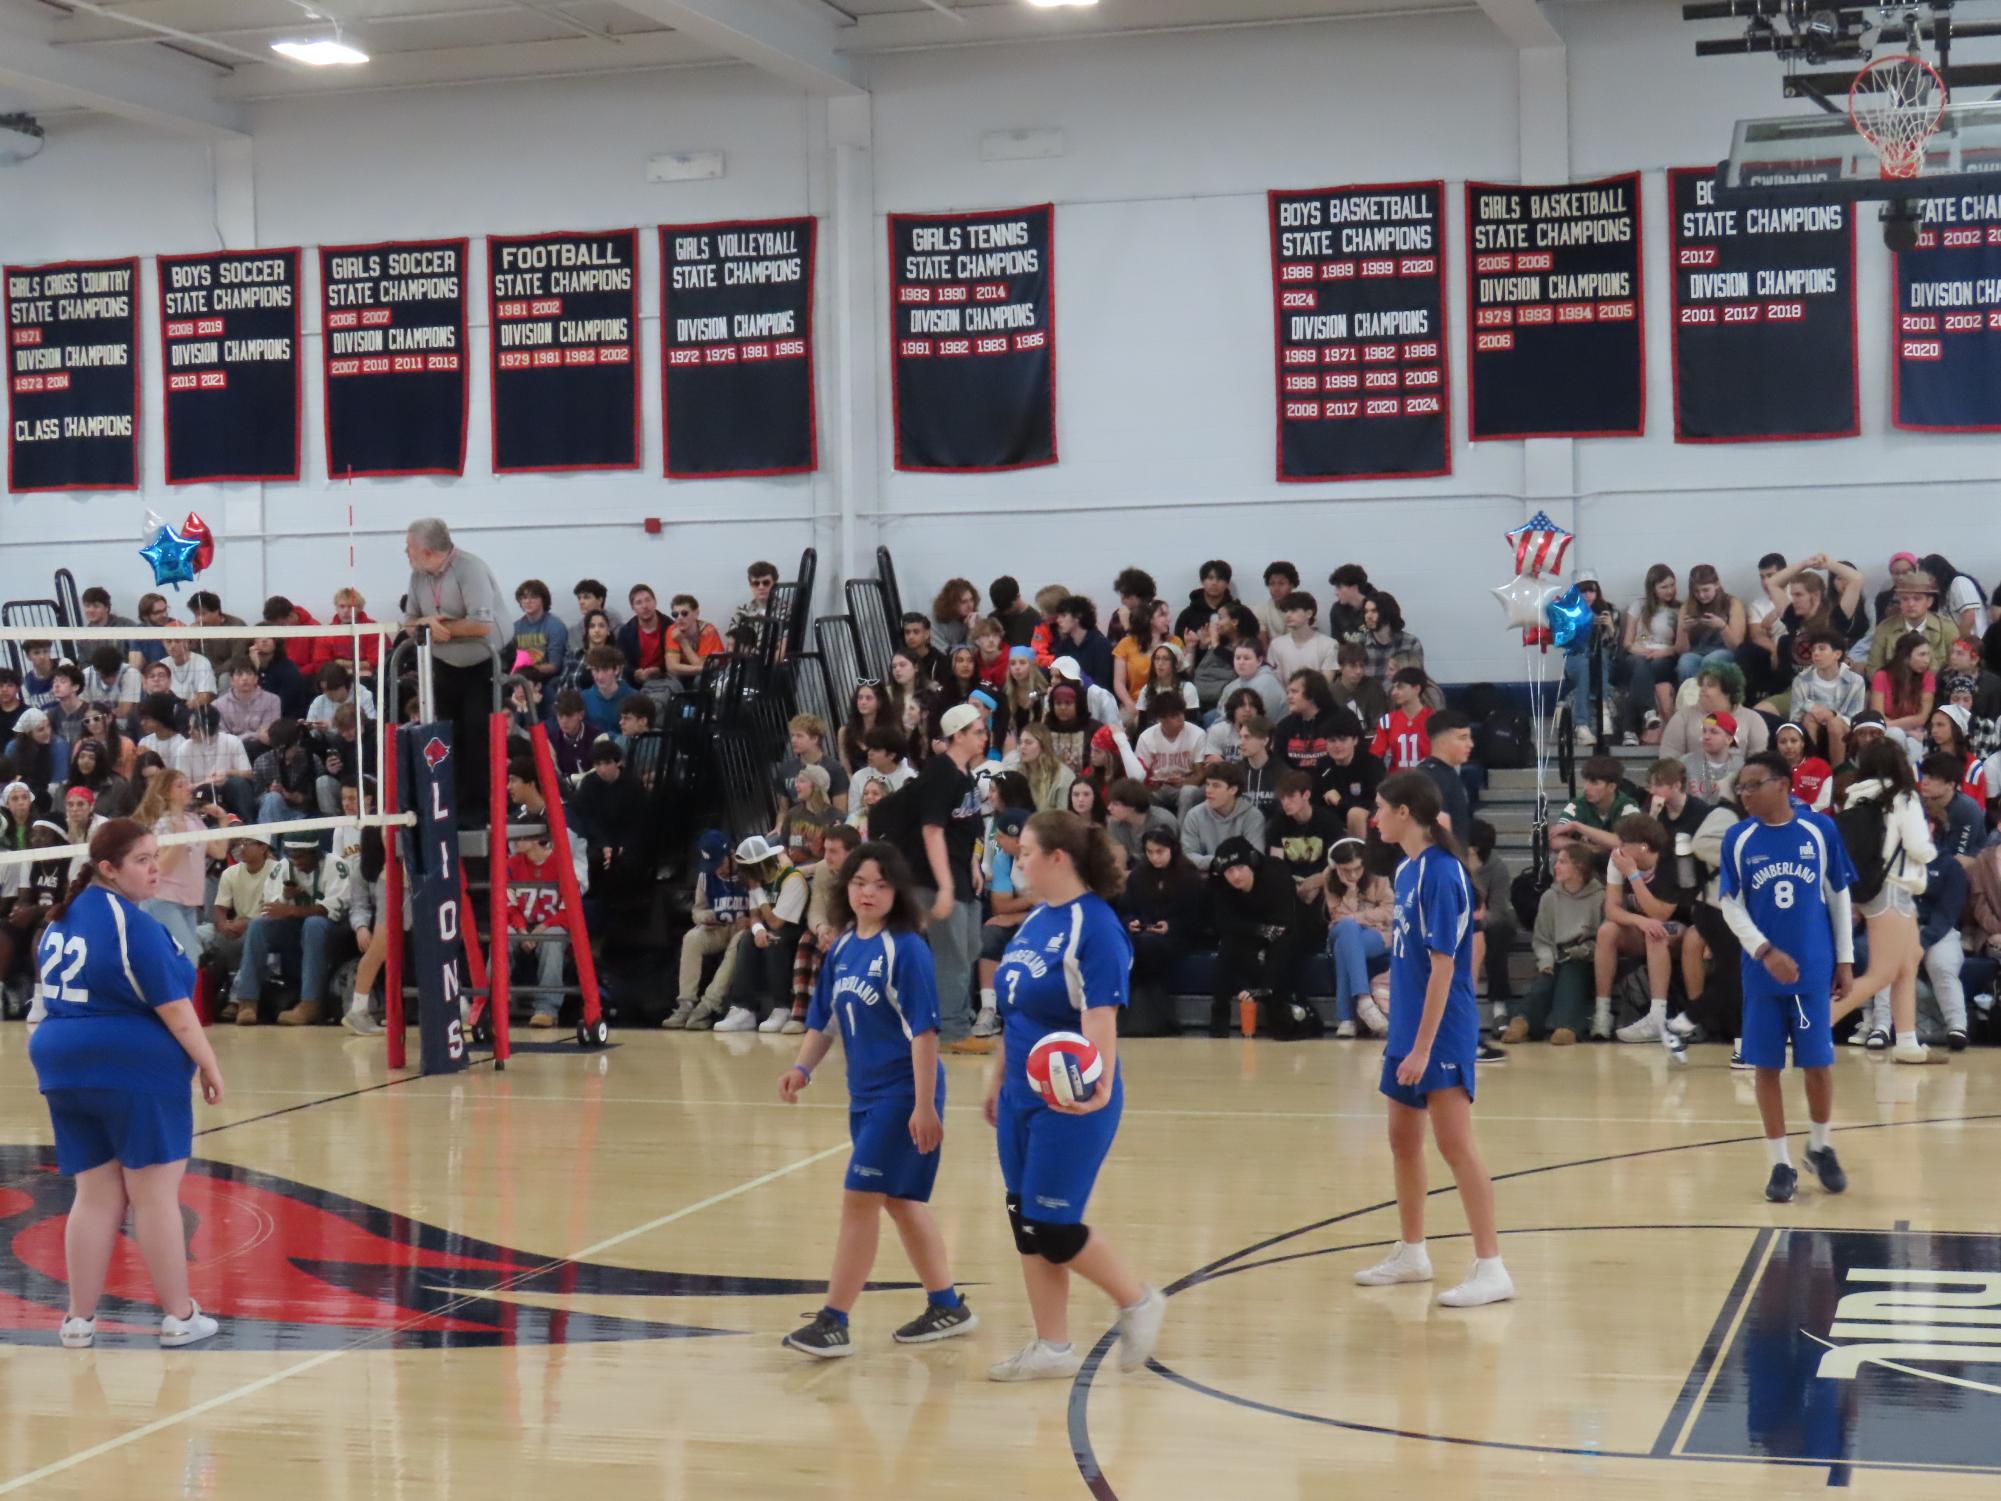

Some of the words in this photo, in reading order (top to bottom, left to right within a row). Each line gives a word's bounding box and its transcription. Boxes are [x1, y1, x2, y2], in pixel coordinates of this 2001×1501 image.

[1281, 202, 1321, 226] BOYS
[1330, 194, 1432, 223] BASKETBALL
[1480, 196, 1520, 219] GIRLS
[1531, 188, 1627, 218] BASKETBALL
[1475, 224, 1528, 249] STATE
[1537, 218, 1630, 246] CHAMPIONS
[1683, 211, 1736, 237] STATE
[1747, 205, 1842, 233] CHAMPIONS
[676, 237, 709, 260] GIRLS
[718, 231, 797, 257] VOLLEYBALL
[913, 227, 961, 251] GIRLS
[967, 222, 1028, 248] TENNIS
[1283, 231, 1332, 256] STATE
[1342, 226, 1431, 252] CHAMPIONS
[1944, 231, 1981, 246] 2002
[333, 256, 379, 279] GIRLS
[389, 251, 455, 276] SOCCER
[503, 243, 620, 269] FOOTBALL
[907, 256, 951, 279] STATE
[957, 250, 1038, 278] CHAMPIONS
[1402, 260, 1433, 273] 2020
[1479, 258, 1509, 270] 2005
[1518, 255, 1550, 268] 2006
[1681, 251, 1714, 264] 2017
[10, 277, 39, 298] GIRLS
[44, 274, 77, 296] CROSS
[82, 270, 130, 293] COUNTRY
[172, 266, 210, 287] BOYS
[220, 260, 285, 283] SOCCER
[496, 274, 542, 296] STATE
[551, 269, 631, 293] CHAMPIONS
[673, 265, 716, 289] STATE
[725, 258, 800, 285] CHAMPIONS
[1690, 272, 1748, 299] DIVISION
[1757, 268, 1836, 295] CHAMPIONS
[166, 292, 207, 314] STATE
[214, 286, 291, 310] CHAMPIONS
[329, 283, 373, 306] STATE
[380, 278, 458, 302] CHAMPIONS
[977, 286, 1005, 299] 2014
[1283, 293, 1314, 306] 2024
[1480, 277, 1540, 302] DIVISION
[1549, 272, 1629, 299] CHAMPIONS
[1911, 281, 1973, 307] DIVISION
[12, 302, 52, 323] STATE
[59, 298, 128, 320] CHAMPIONS
[363, 312, 389, 324] 2007
[499, 303, 527, 315] 1981
[533, 302, 560, 314] 2002
[911, 309, 960, 332] DIVISION
[966, 303, 1035, 331] CHAMPIONS
[1478, 311, 1511, 324] 1979
[1600, 304, 1632, 317] 2005
[1682, 309, 1716, 322] 2001
[1725, 307, 1758, 320] 2017
[1768, 305, 1800, 318] 2018
[501, 321, 551, 346] DIVISION
[560, 318, 627, 342] CHAMPIONS
[677, 317, 727, 341] DIVISION
[734, 310, 794, 337] CHAMPIONS
[1292, 314, 1346, 340] DIVISION
[1355, 310, 1428, 337] CHAMPIONS
[1903, 317, 1936, 329] 2001
[1946, 315, 1982, 328] 2002
[16, 330, 41, 342] 1971
[333, 330, 383, 354] DIVISION
[389, 326, 455, 350] CHAMPIONS
[902, 342, 929, 354] 1981
[940, 341, 968, 353] 1982
[1016, 333, 1043, 348] 1985
[1479, 335, 1510, 348] 2006
[16, 348, 61, 370] DIVISION
[66, 345, 127, 366] CHAMPIONS
[172, 342, 218, 366] DIVISION
[224, 340, 290, 362] CHAMPIONS
[501, 353, 529, 366] 1979
[534, 353, 560, 364] 1981
[565, 350, 595, 362] 1982
[600, 349, 628, 361] 2002
[671, 351, 699, 363] 1972
[706, 348, 735, 361] 1975
[743, 346, 768, 358] 1981
[776, 342, 803, 355] 1985
[1324, 348, 1356, 361] 1971
[1365, 347, 1395, 360] 1982
[1904, 343, 1938, 356] 2020
[332, 362, 358, 373] 2007
[363, 359, 389, 371] 2010
[395, 357, 423, 369] 2011
[428, 357, 457, 369] 2013
[16, 377, 42, 389] 1972
[172, 375, 196, 387] 2013
[202, 374, 224, 385] 2021
[1326, 375, 1357, 388] 1999
[1366, 373, 1396, 386] 2003
[1406, 371, 1437, 384] 2006
[1288, 403, 1317, 417] 2008
[1327, 403, 1357, 416] 2017
[1368, 401, 1397, 414] 2020
[1407, 398, 1439, 412] 2024
[16, 420, 59, 441] CLASS
[65, 416, 132, 438] CHAMPIONS
[1752, 862, 1816, 890] CUMBERLAND
[1774, 880, 1794, 909] 8
[40, 931, 89, 1003] 22
[1005, 969, 1022, 1005] 7
[846, 1002, 856, 1037] 1
